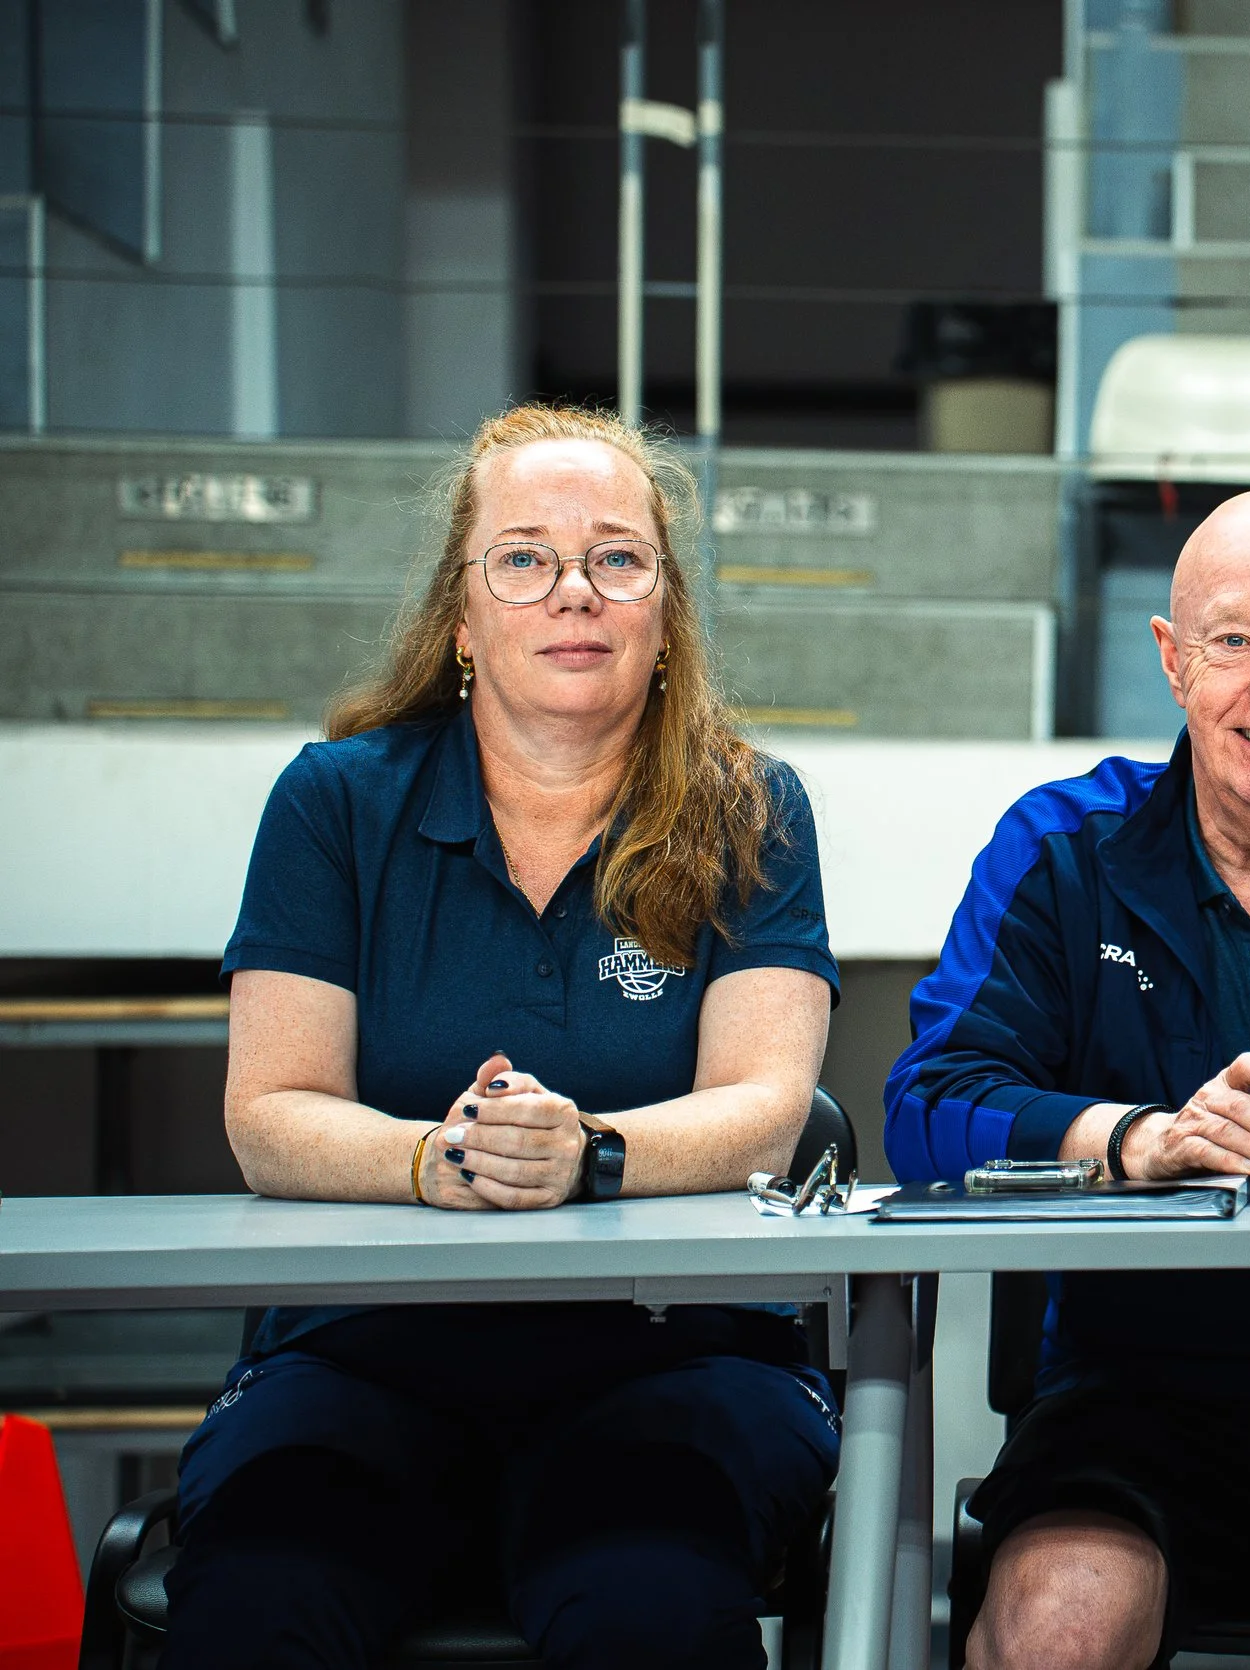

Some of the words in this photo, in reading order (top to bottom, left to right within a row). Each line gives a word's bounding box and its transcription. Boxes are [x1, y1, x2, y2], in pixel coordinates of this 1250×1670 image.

[619, 940, 641, 949] LAND
[598, 952, 685, 981] HAMM
[622, 988, 664, 1001] ZWOLLE
